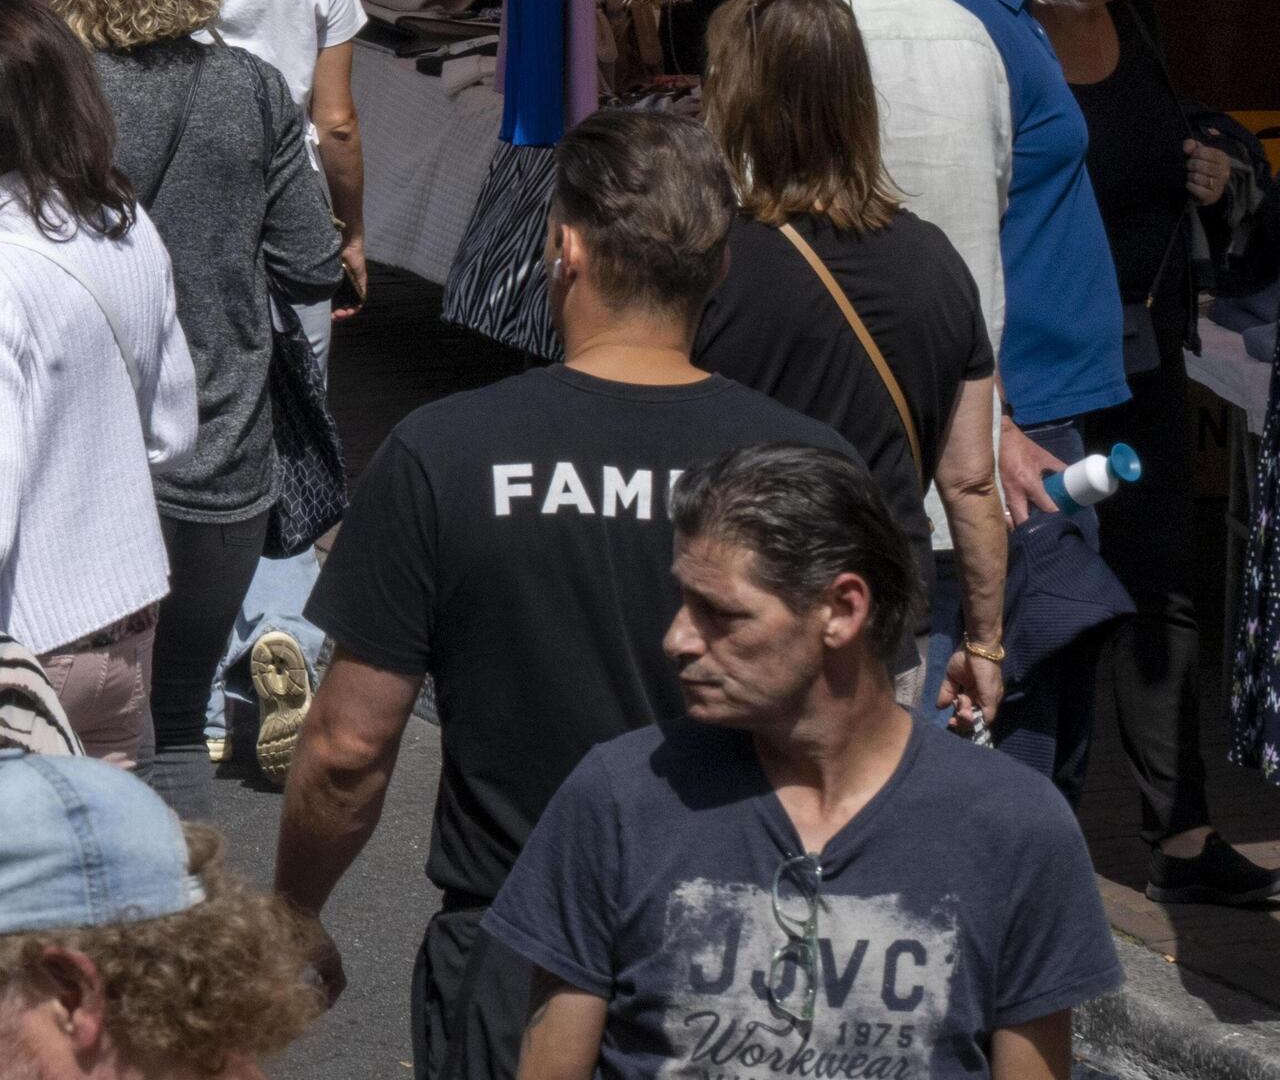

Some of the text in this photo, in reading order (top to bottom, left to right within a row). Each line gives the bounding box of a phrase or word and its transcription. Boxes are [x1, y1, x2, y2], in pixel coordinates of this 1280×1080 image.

[492, 461, 686, 519] FAM
[684, 1011, 914, 1080] Workwear
[838, 1023, 916, 1050] 1975
